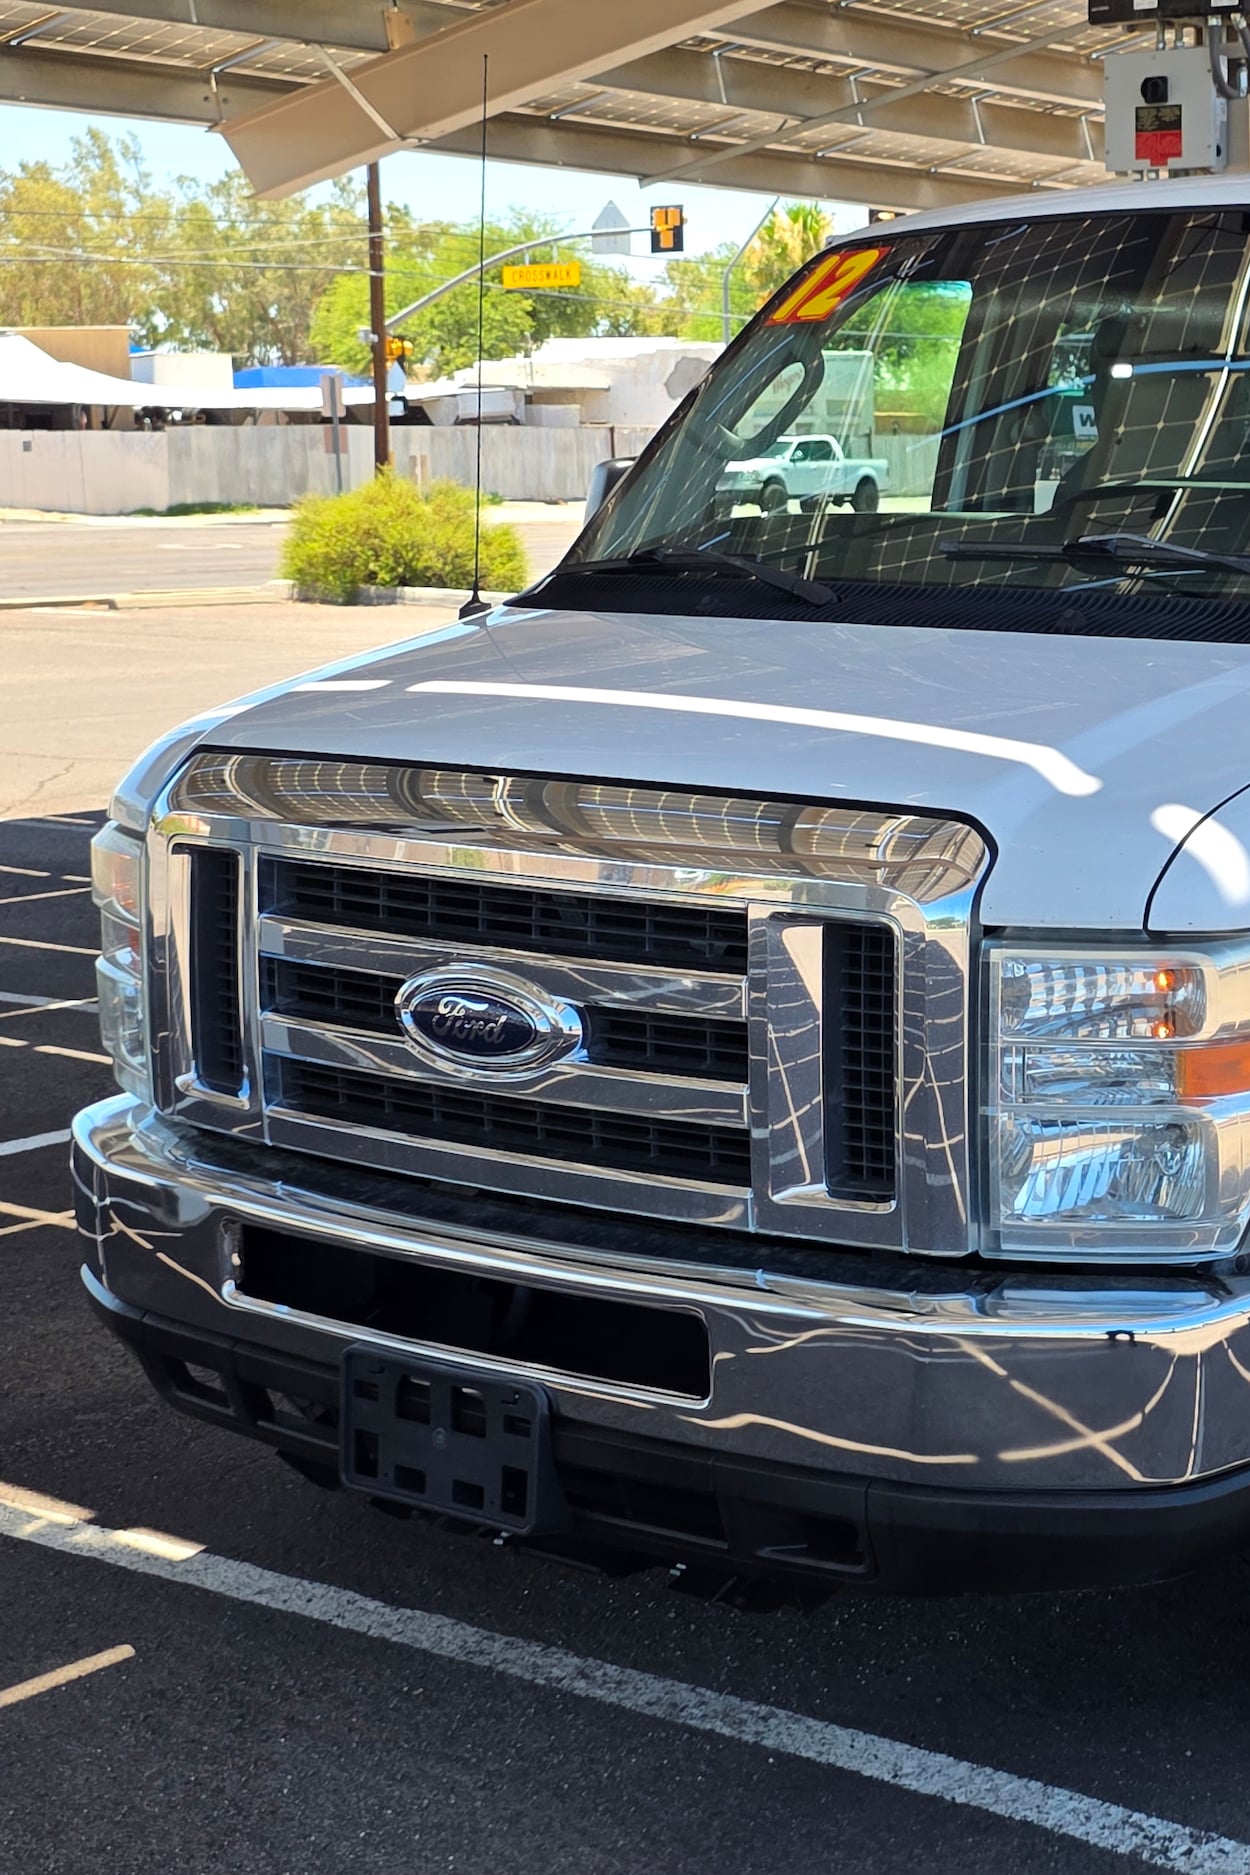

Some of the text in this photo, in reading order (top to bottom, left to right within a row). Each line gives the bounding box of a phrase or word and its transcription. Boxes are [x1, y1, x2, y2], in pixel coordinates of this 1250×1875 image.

[511, 269, 573, 283] CROSSWALK
[772, 249, 880, 322] 12
[431, 996, 509, 1044] Ford
